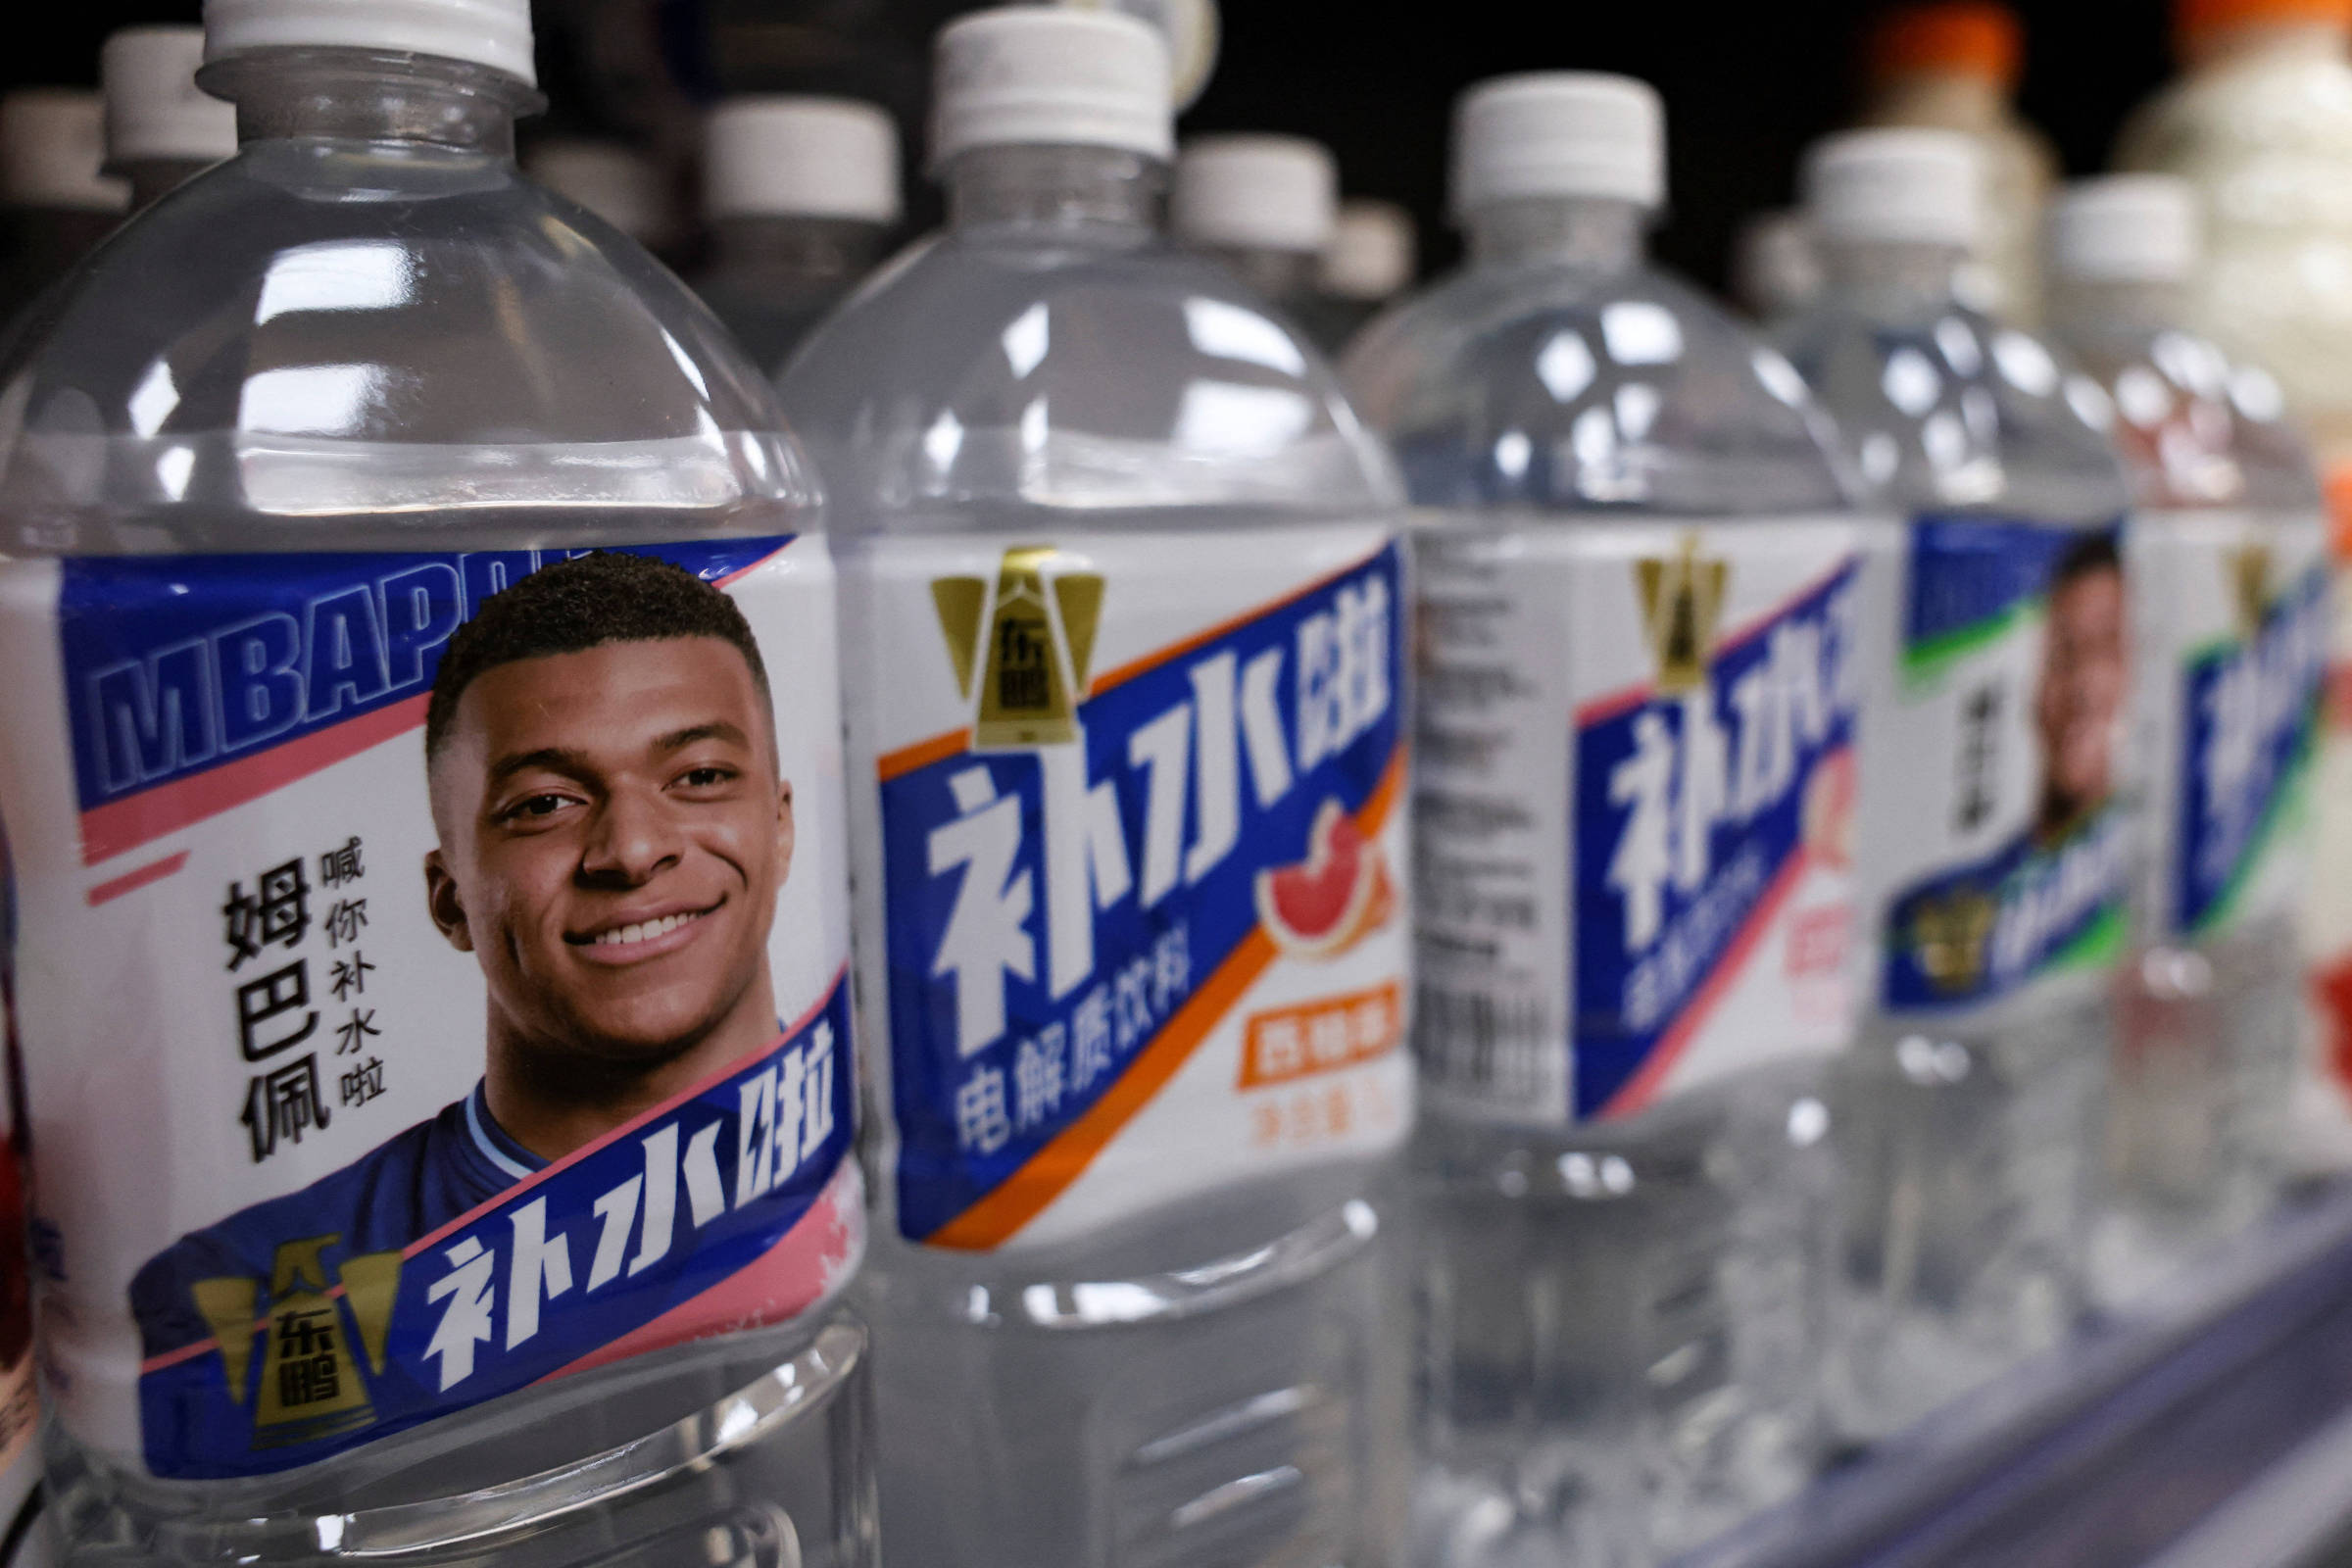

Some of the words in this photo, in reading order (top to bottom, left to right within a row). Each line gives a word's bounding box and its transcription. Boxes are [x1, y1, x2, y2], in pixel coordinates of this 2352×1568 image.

[88, 549, 594, 795] MBAP
[926, 571, 1392, 1060] 补水啦
[221, 856, 333, 1164] 姆巴佩
[319, 835, 387, 1108] 喊你补水啦
[956, 923, 1192, 1153] 电解质饮料
[421, 1020, 837, 1394] 补水啦
[275, 1307, 341, 1408] 东鹏
